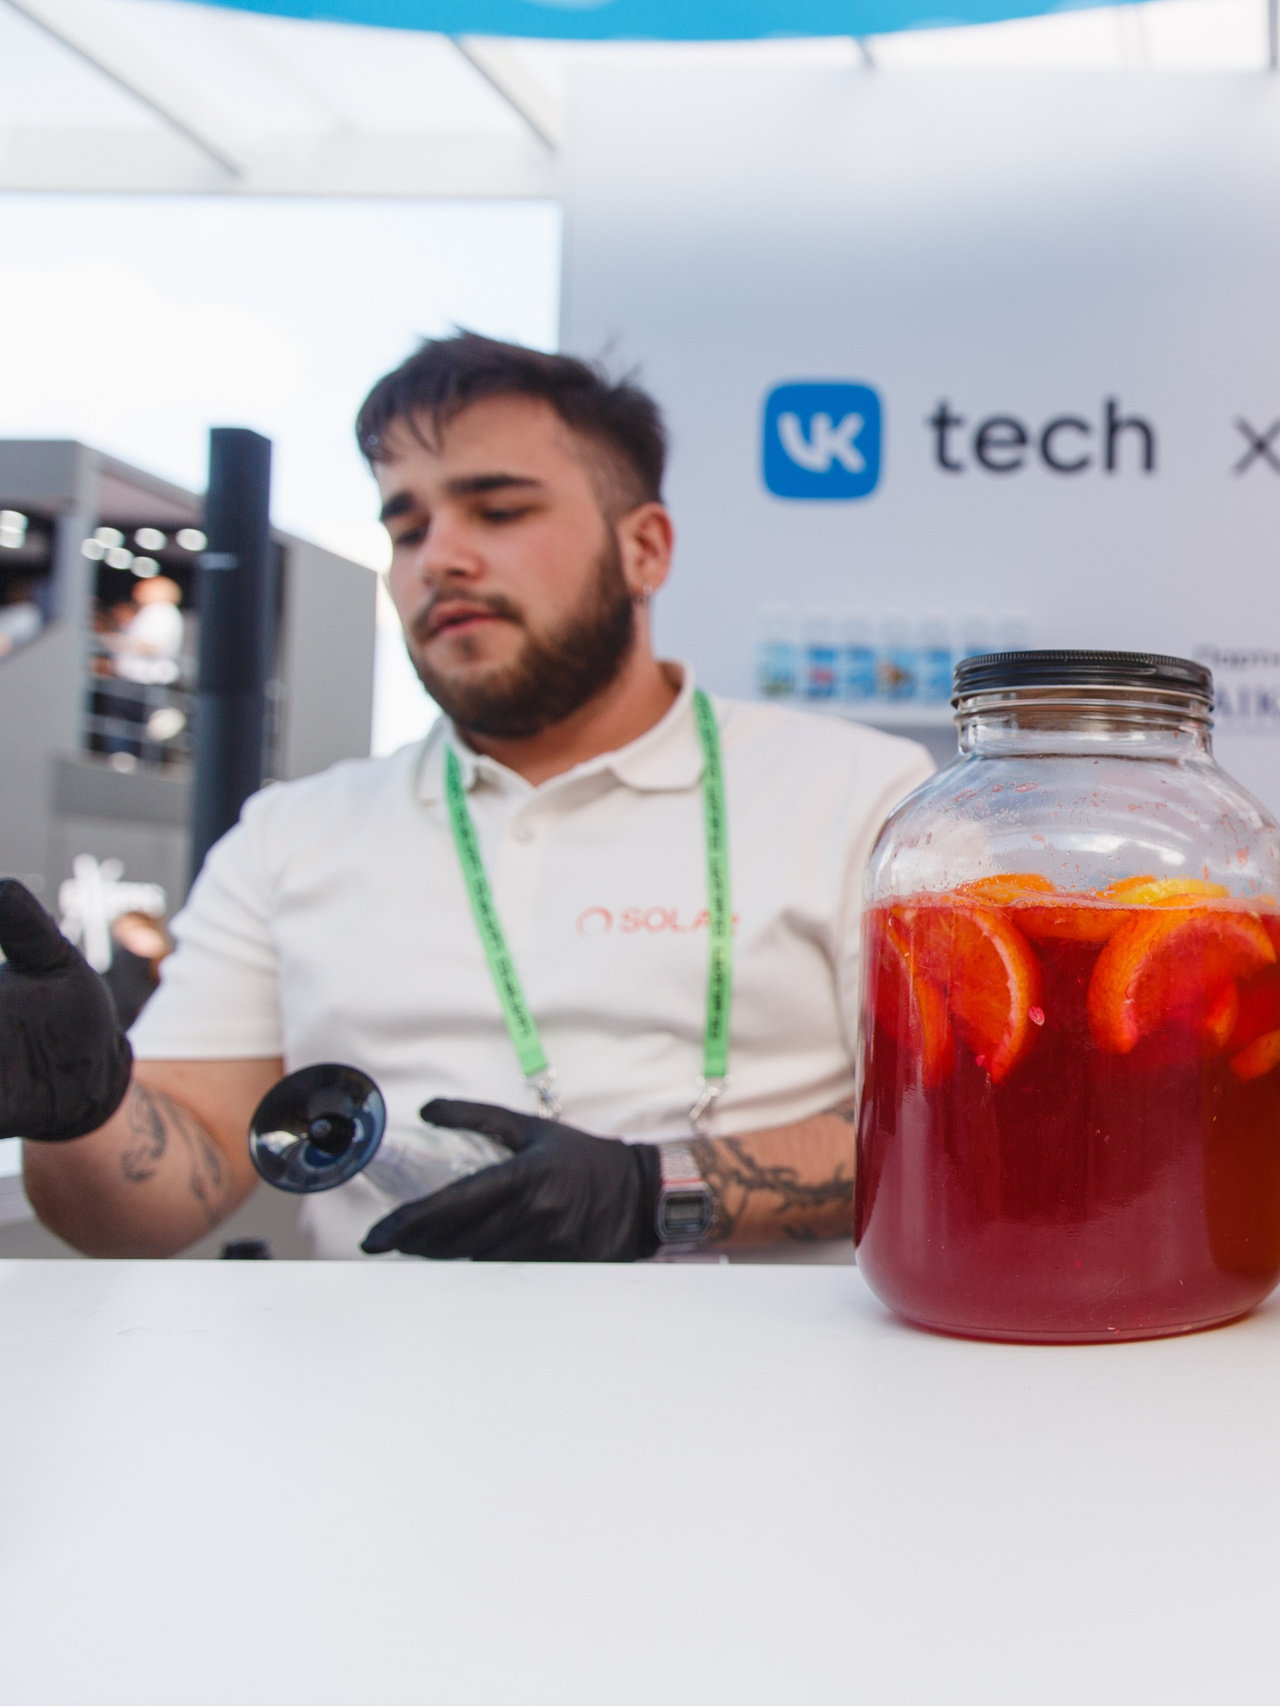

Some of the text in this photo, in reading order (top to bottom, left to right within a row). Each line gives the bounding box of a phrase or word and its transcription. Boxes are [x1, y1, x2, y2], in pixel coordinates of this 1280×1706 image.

[778, 412, 866, 474] VK
[927, 399, 1156, 475] tech
[620, 906, 740, 936] SOLA
